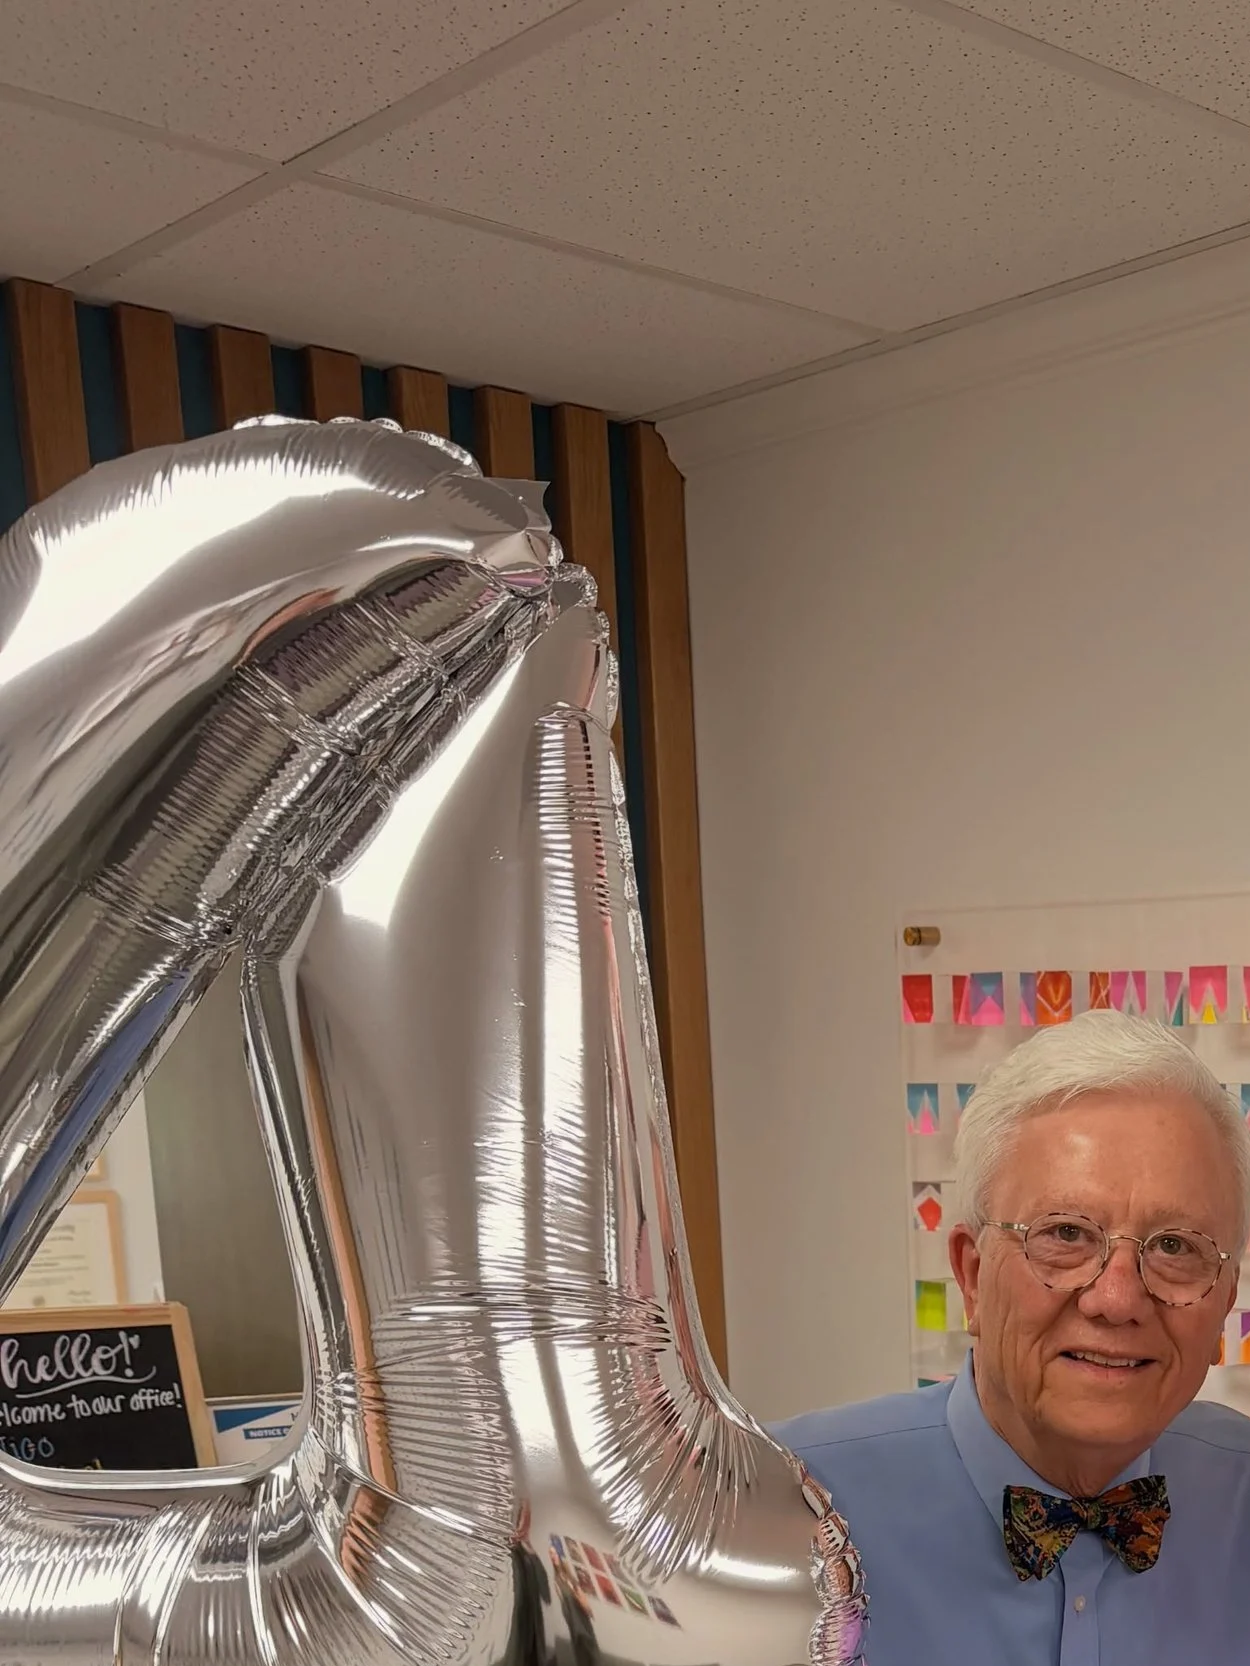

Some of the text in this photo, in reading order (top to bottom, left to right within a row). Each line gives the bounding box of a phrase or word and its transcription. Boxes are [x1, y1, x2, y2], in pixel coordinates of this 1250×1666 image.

[1, 1331, 135, 1389] hello!
[67, 1394, 91, 1419] to
[130, 1382, 183, 1412] office!
